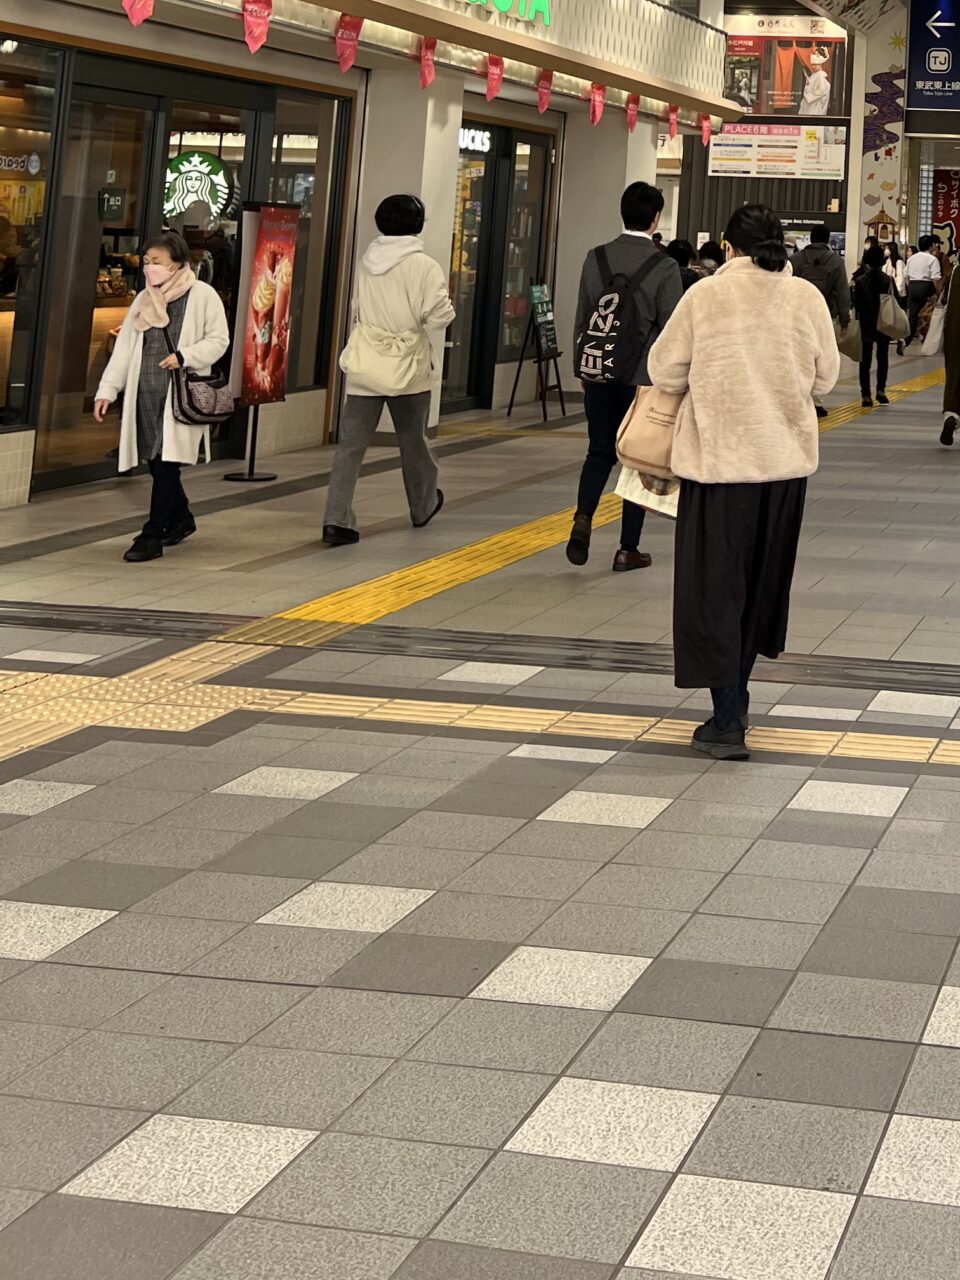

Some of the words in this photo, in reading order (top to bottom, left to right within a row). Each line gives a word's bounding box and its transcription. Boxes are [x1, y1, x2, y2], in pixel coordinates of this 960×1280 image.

[931, 56, 947, 66] TJ
[915, 81, 960, 91] 東武東上線
[949, 180, 960, 218] サイボク
